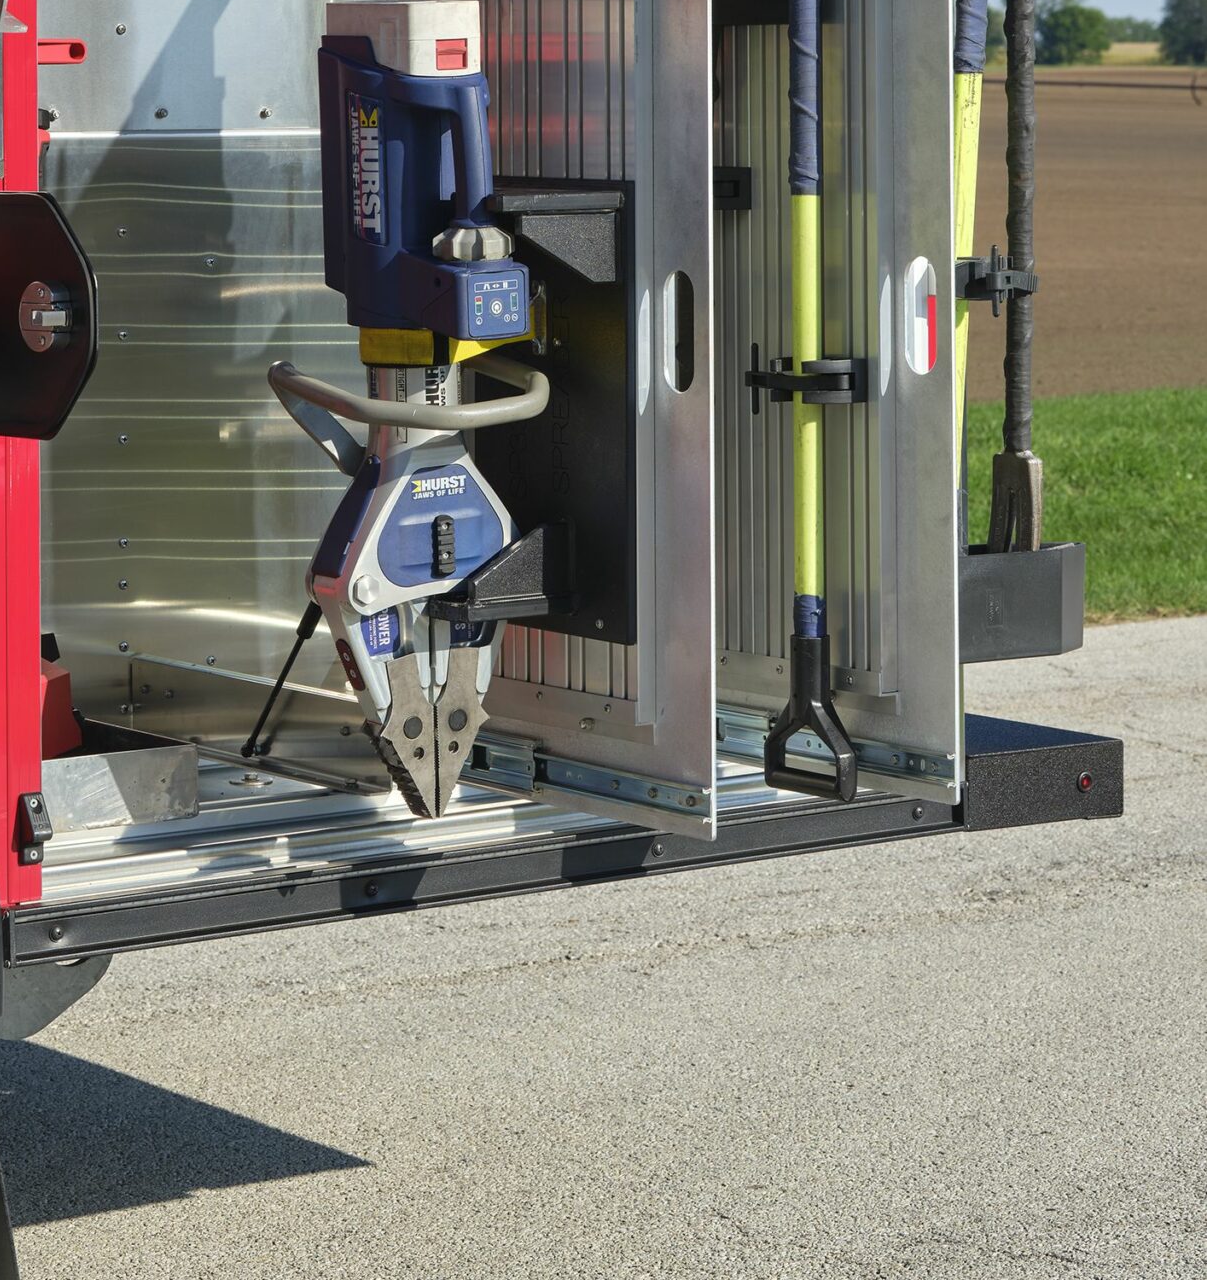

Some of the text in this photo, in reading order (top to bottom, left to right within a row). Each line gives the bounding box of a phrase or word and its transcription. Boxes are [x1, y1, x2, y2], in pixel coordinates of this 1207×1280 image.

[359, 127, 382, 234] HURST
[421, 475, 466, 492] HURST
[413, 487, 464, 500] JAWS OF LIFE
